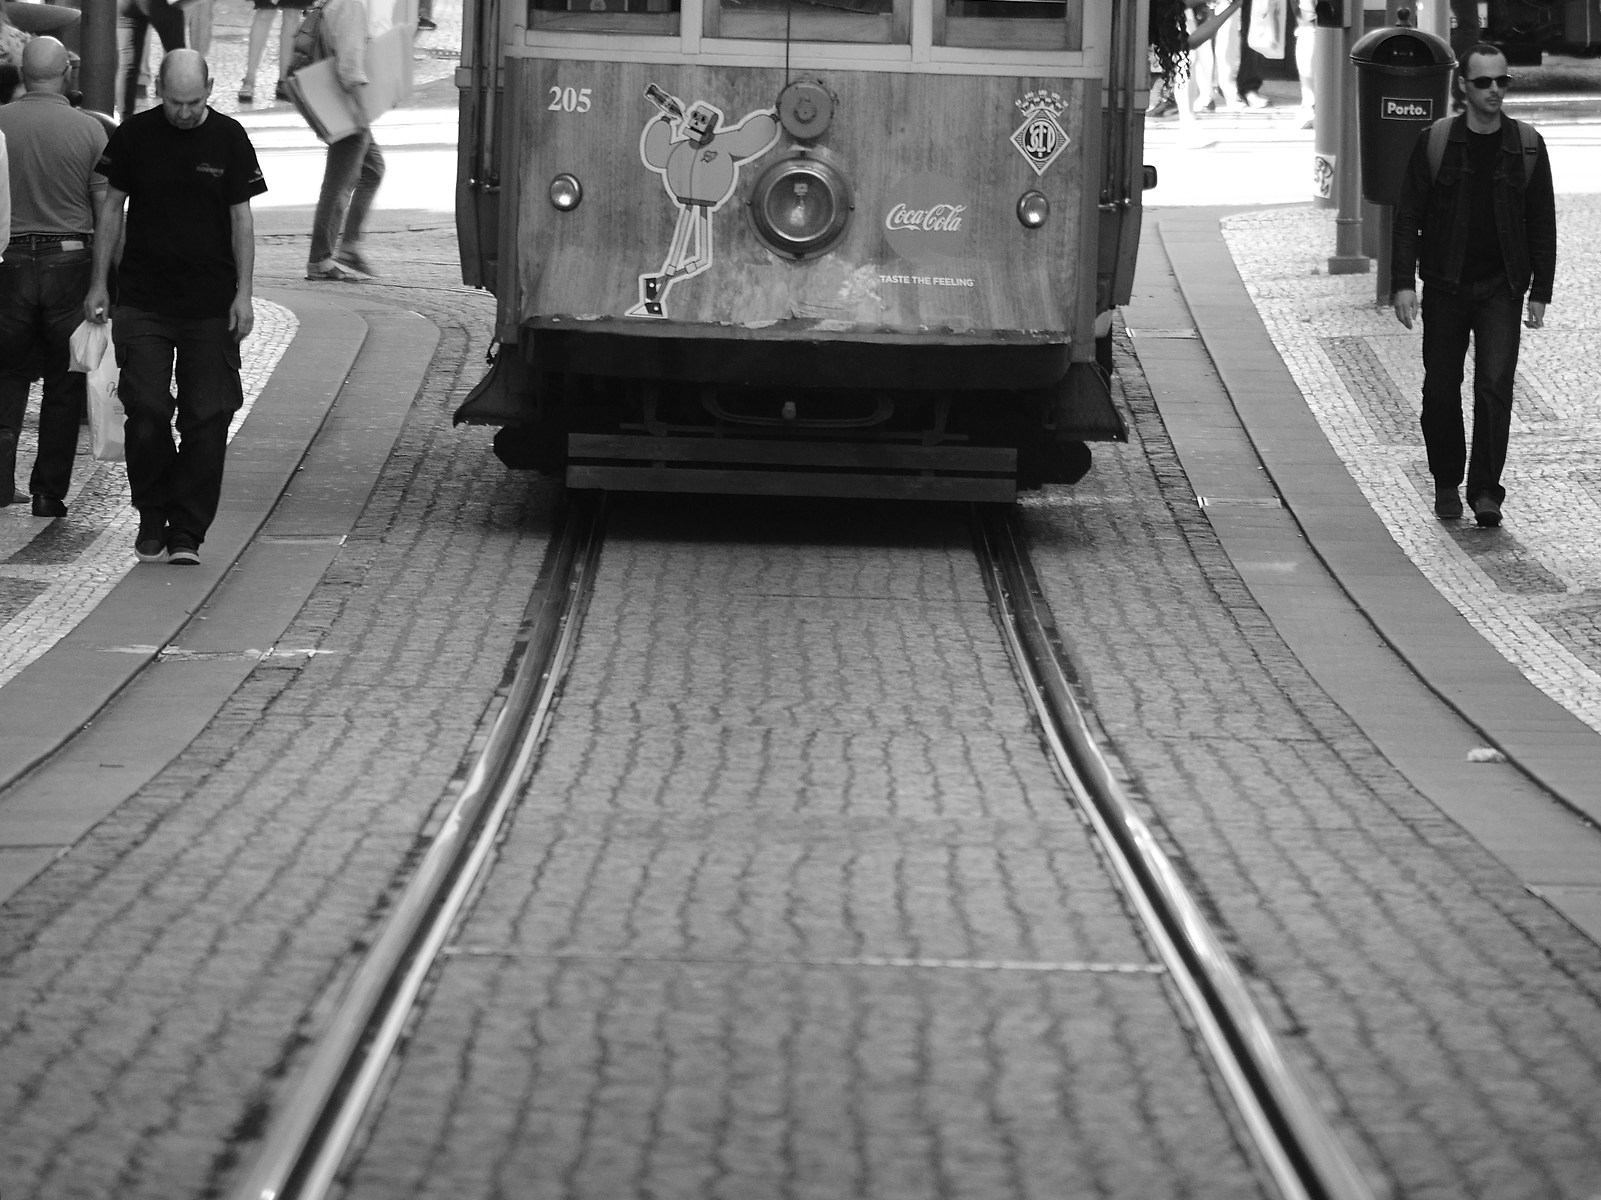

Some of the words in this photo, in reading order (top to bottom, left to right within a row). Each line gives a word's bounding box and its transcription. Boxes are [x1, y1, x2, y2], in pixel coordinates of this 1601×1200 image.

[548, 86, 593, 113] 205
[1387, 101, 1427, 116] Porto.
[885, 203, 967, 232] Coca-Cola
[879, 275, 910, 285] TASTE
[911, 276, 931, 286] THE
[932, 277, 974, 288] FEELING
